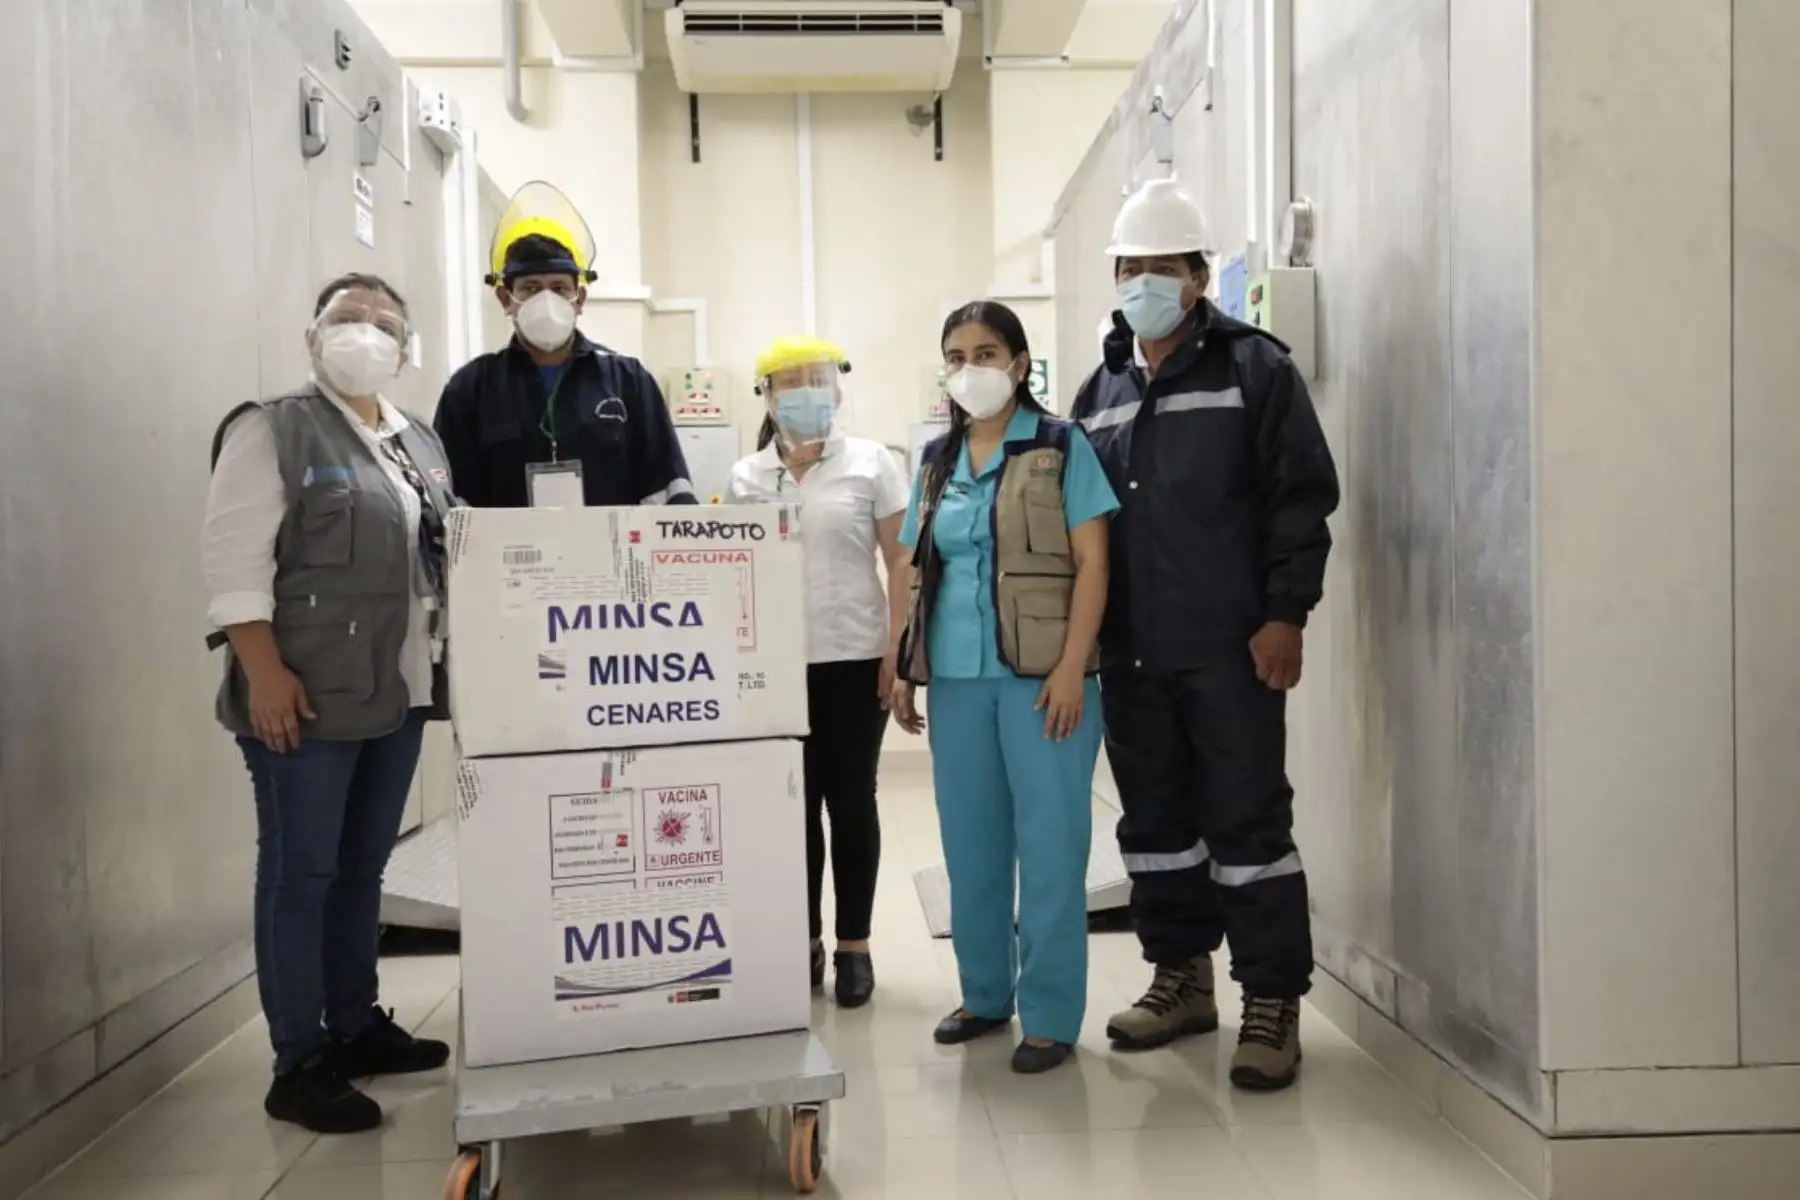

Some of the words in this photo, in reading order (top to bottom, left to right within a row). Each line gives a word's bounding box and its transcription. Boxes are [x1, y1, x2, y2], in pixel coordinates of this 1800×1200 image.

[656, 519, 766, 541] TARAPOTO
[656, 552, 749, 565] VACUNA
[588, 651, 715, 686] MINSA
[587, 699, 720, 726] CENARES
[658, 788, 708, 805] VACINA
[660, 850, 721, 867] URGENTE
[564, 912, 727, 965] MINSA
